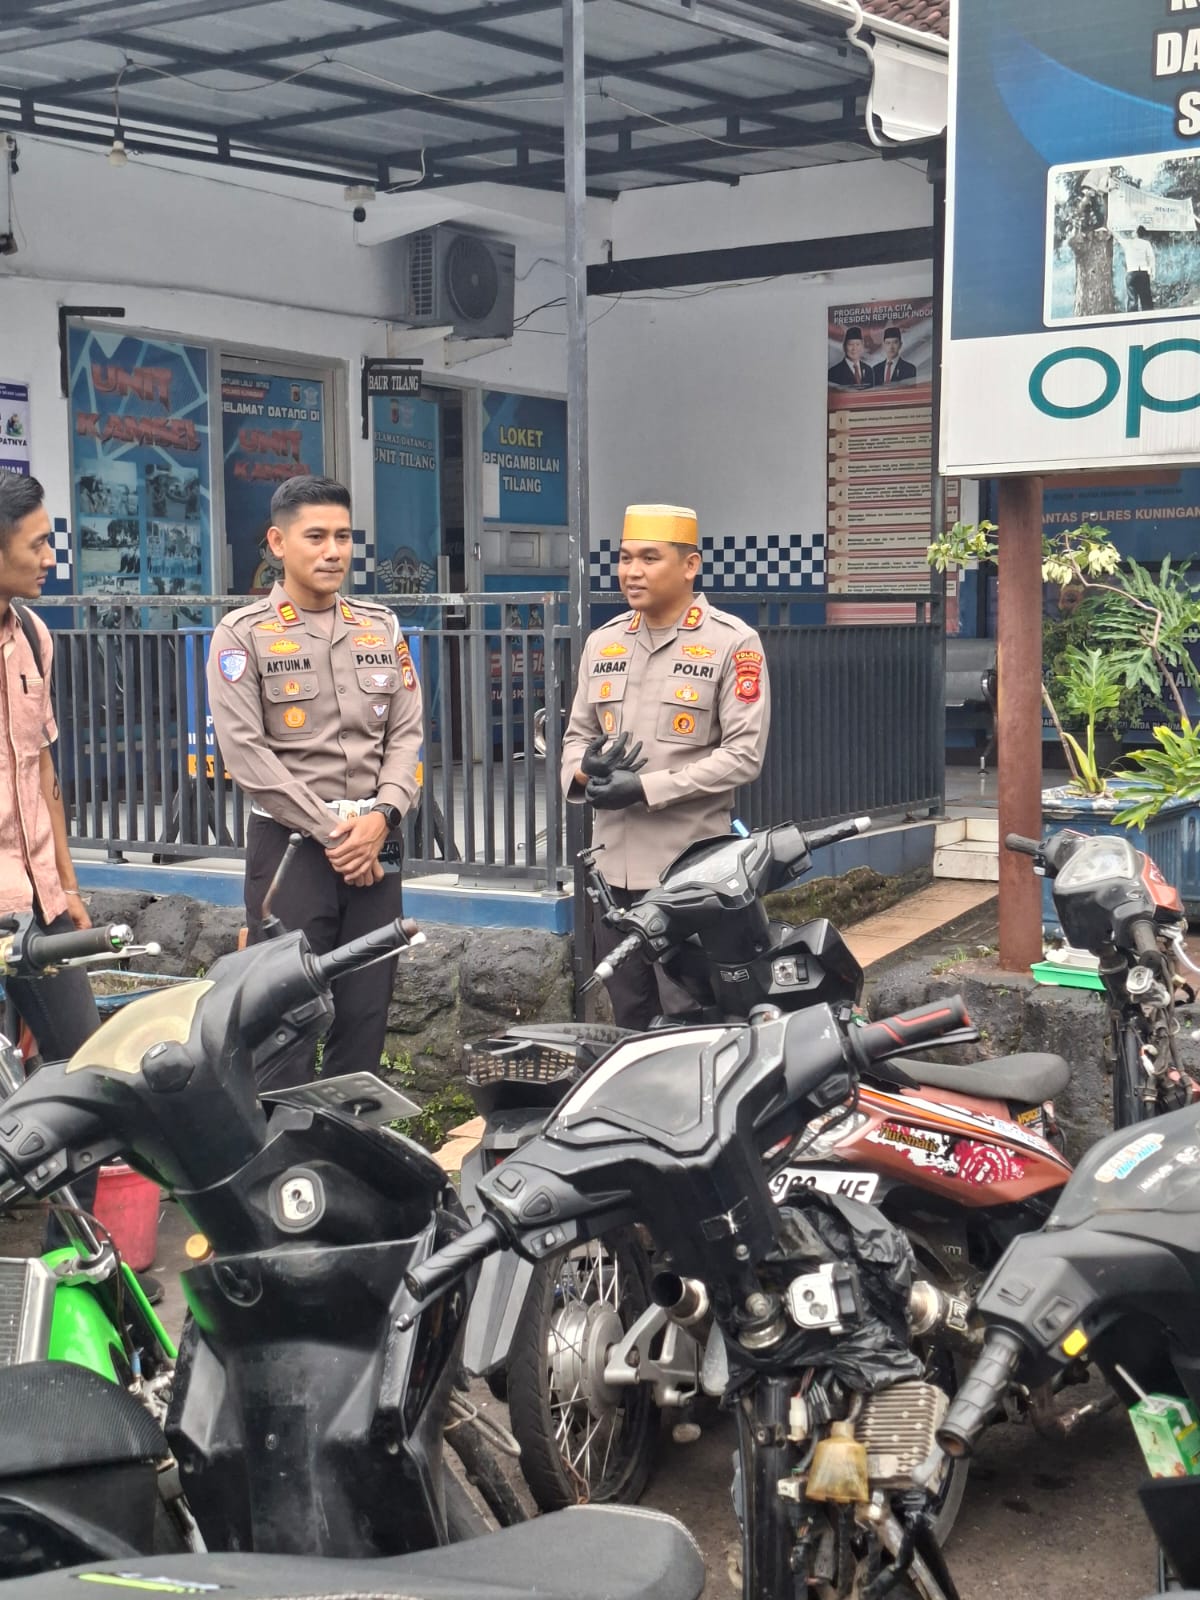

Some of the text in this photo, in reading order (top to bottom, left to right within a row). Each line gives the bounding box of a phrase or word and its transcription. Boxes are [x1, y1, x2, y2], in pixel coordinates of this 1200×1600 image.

[834, 303, 912, 317] PROGRAM ASTA CITA
[834, 315, 871, 324] PRESIDEN
[872, 311, 909, 321] REPUBLIK
[92, 363, 172, 413] UNIT
[369, 375, 419, 391] BAUR TILANG
[268, 405, 307, 420] DATANG
[310, 409, 320, 421] DI
[500, 426, 543, 448] LOKET
[239, 429, 303, 462] UNIT
[399, 452, 436, 470] TILANG
[483, 452, 560, 473] PENGAMBILAN
[503, 476, 541, 493] TILANG
[1081, 509, 1131, 522] POLRES
[266, 659, 312, 674] AKTUIN.M
[356, 654, 393, 666] POLRI
[593, 661, 627, 674] AKBAR
[673, 663, 714, 679] POLRI
